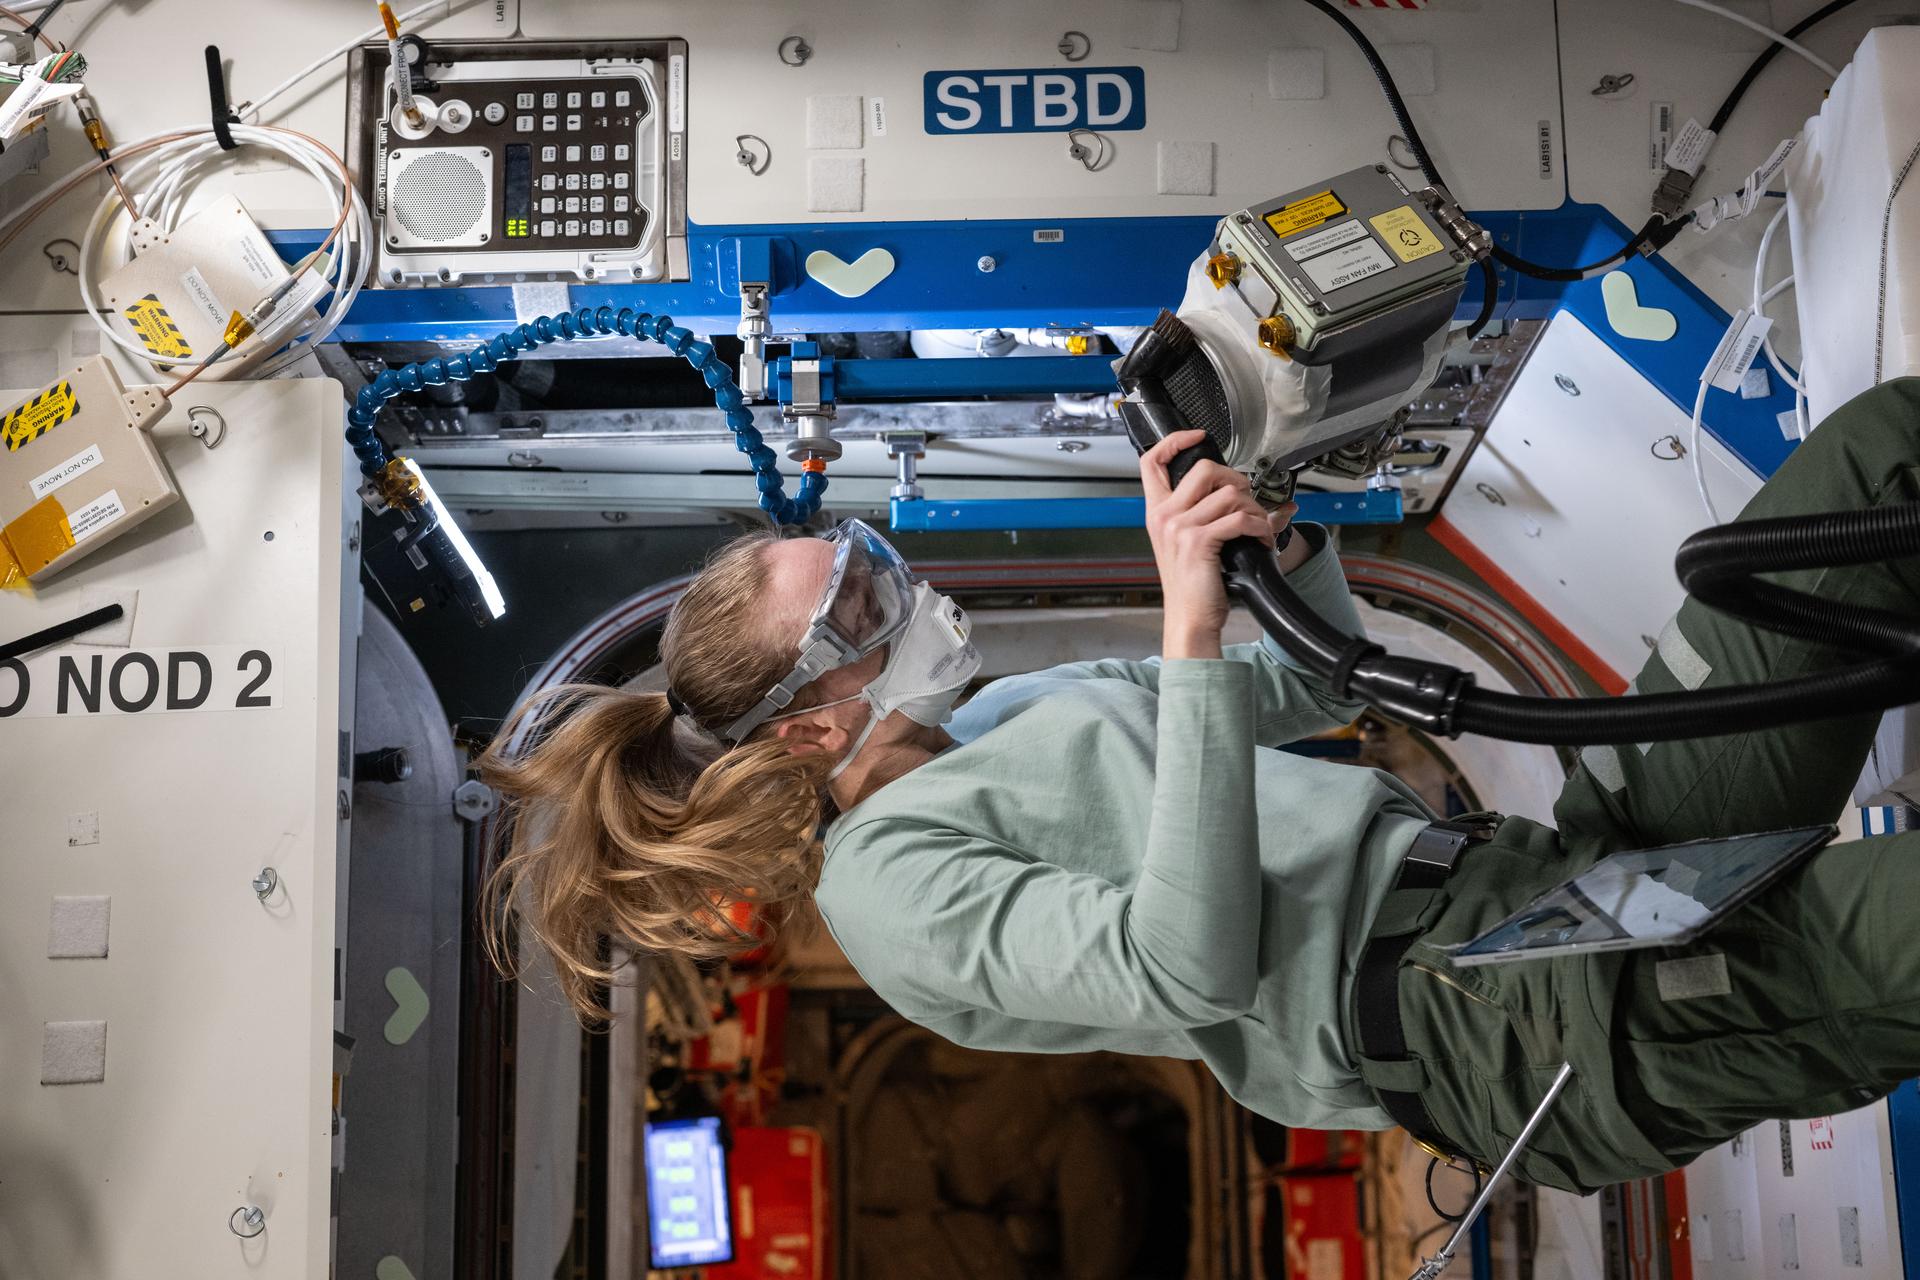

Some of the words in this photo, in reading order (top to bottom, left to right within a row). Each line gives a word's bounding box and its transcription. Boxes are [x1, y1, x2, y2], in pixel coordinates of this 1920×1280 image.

[936, 73, 1132, 130] STBD
[379, 148, 387, 183] TERMINAL
[518, 219, 528, 237] PTT
[1293, 211, 1326, 227] WARNING
[1406, 243, 1436, 259] CAUTION
[1350, 267, 1366, 279] FAN
[1367, 262, 1381, 273] IMV
[1329, 273, 1350, 287] ASSY
[195, 286, 210, 304] NOT
[207, 303, 225, 326] MOVE
[148, 308, 170, 338] WARNING
[32, 405, 65, 428] WARNING
[80, 453, 94, 465] DO
[62, 461, 81, 476] NOT
[37, 472, 63, 491] MOVE
[57, 651, 213, 714] NOD
[235, 649, 272, 708] 2
